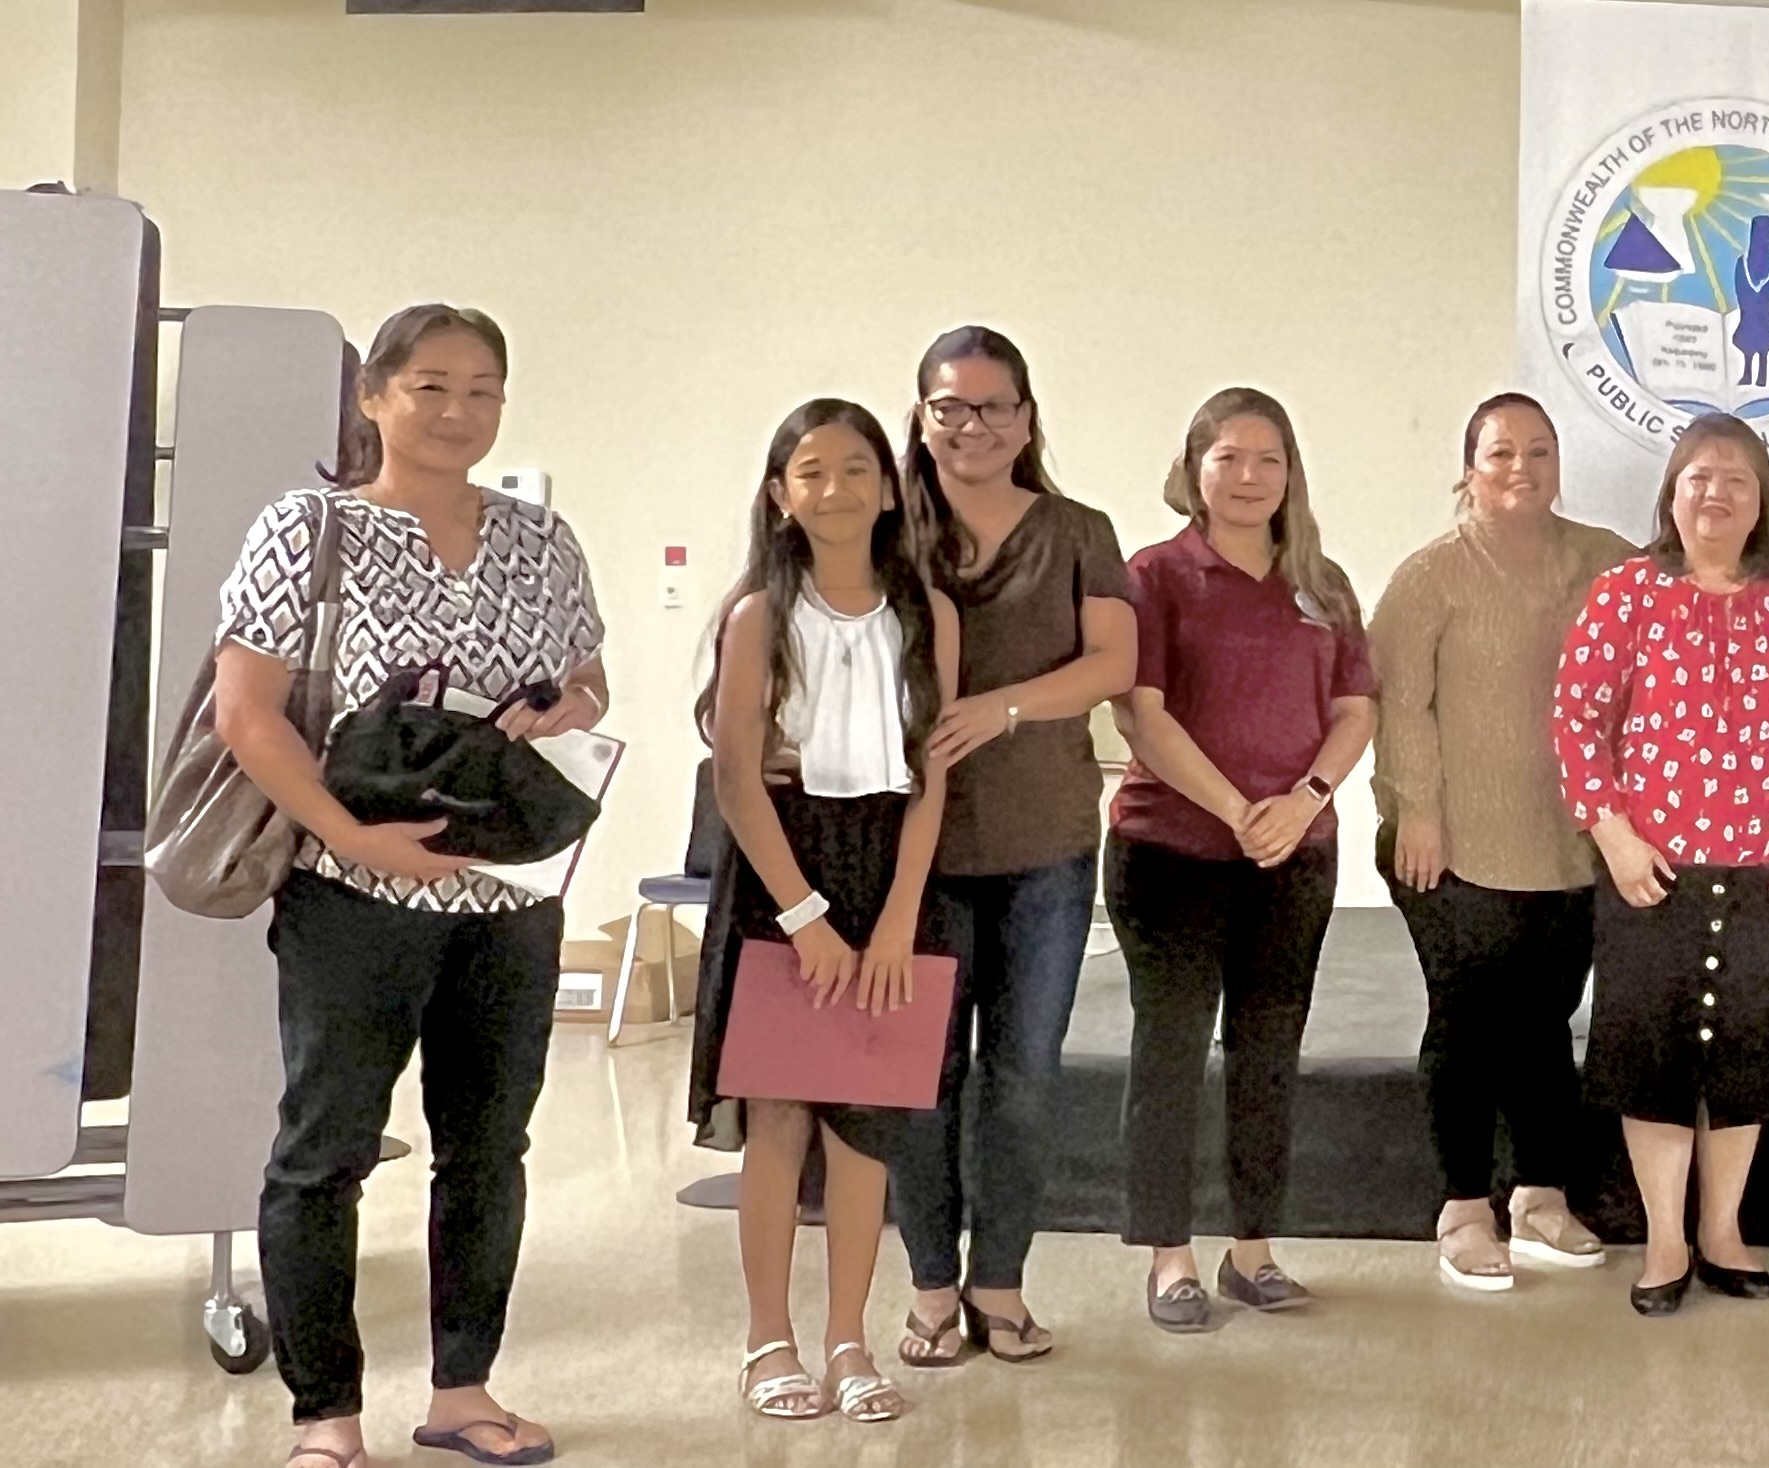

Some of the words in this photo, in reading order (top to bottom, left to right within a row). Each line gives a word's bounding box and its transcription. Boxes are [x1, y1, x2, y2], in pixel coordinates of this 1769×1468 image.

[1554, 147, 1630, 326] COMMONWEALTH
[1628, 126, 1656, 154] OF
[1660, 112, 1703, 139] THE
[1586, 363, 1665, 435] PUBLIC
